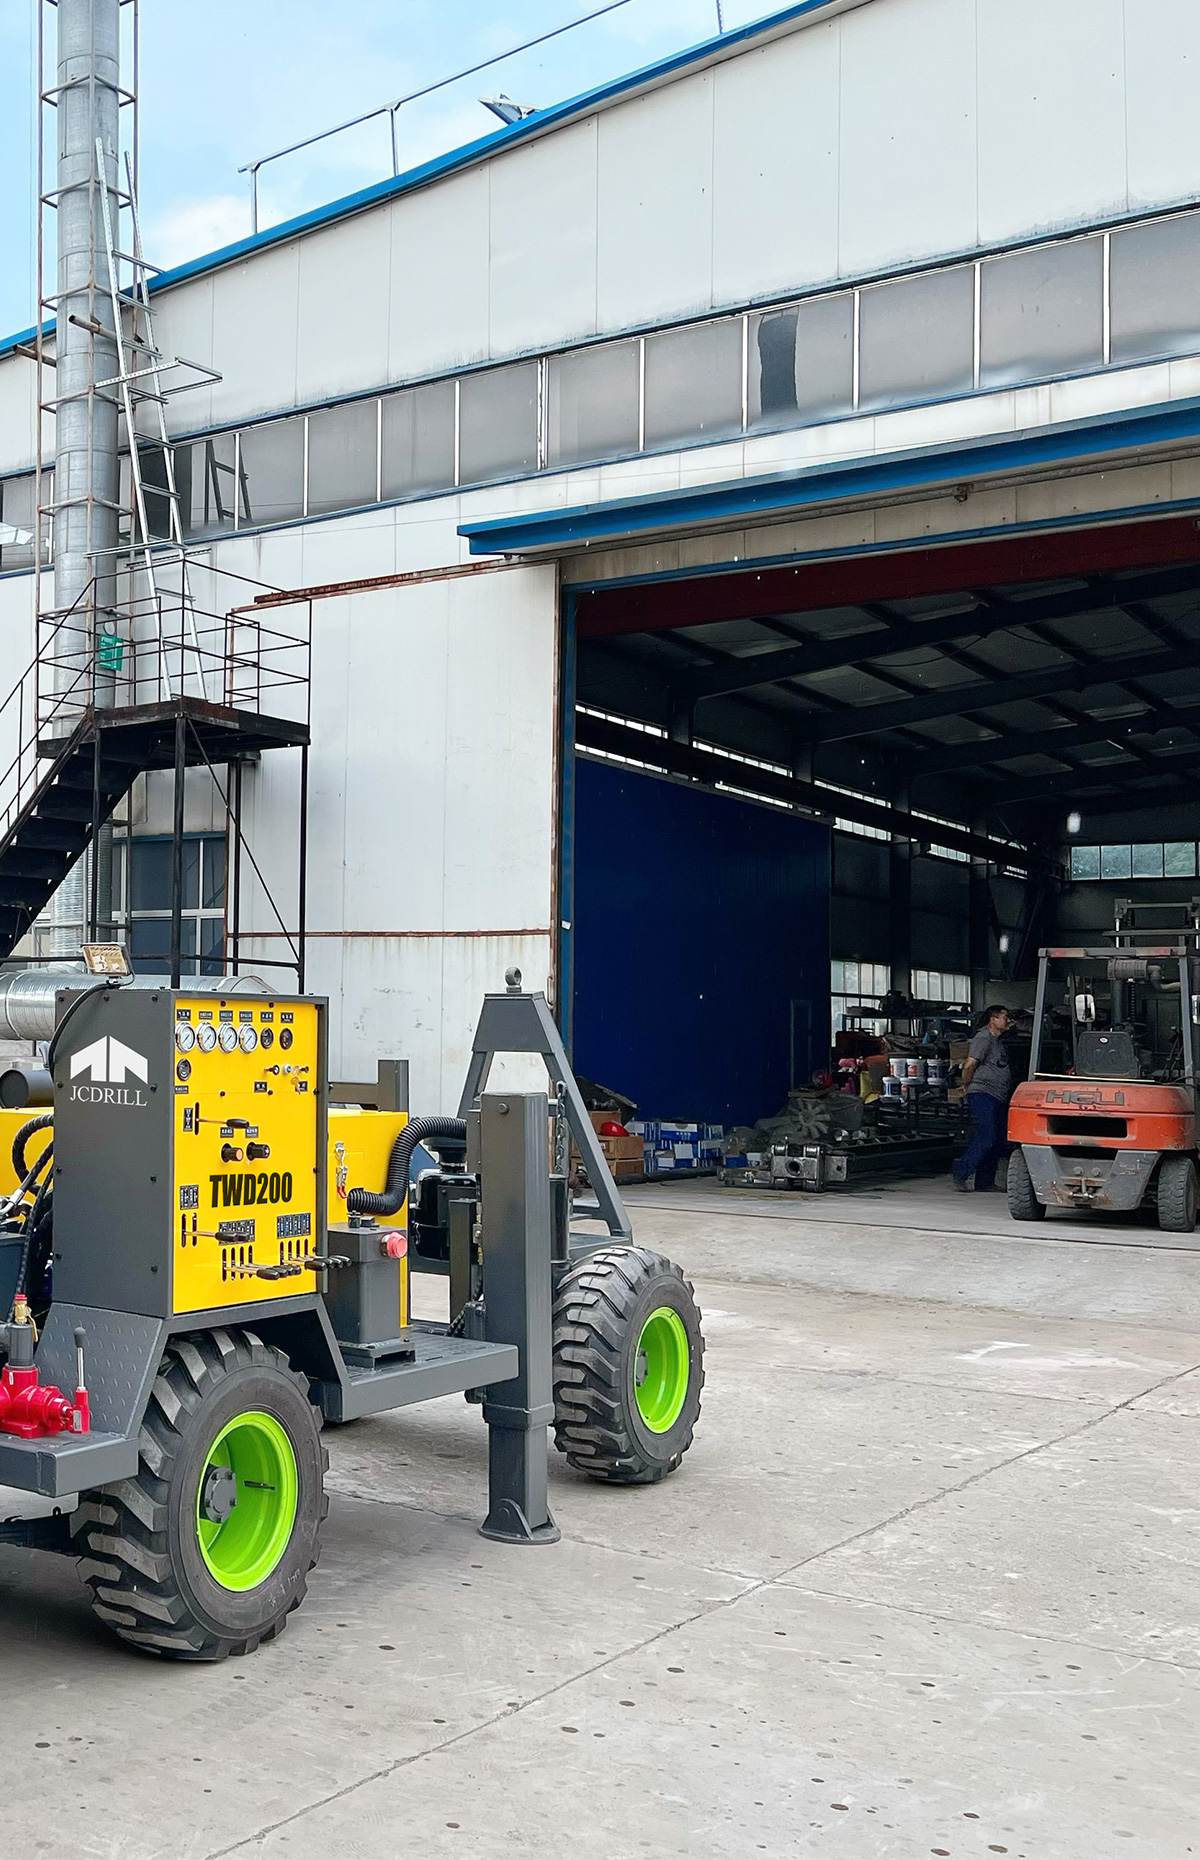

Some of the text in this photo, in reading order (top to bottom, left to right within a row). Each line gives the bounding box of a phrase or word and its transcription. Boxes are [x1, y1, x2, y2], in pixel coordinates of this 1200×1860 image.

[69, 1085, 148, 1107] JCDRILL
[1045, 1089, 1125, 1106] HELI
[209, 1171, 293, 1208] TWD200
